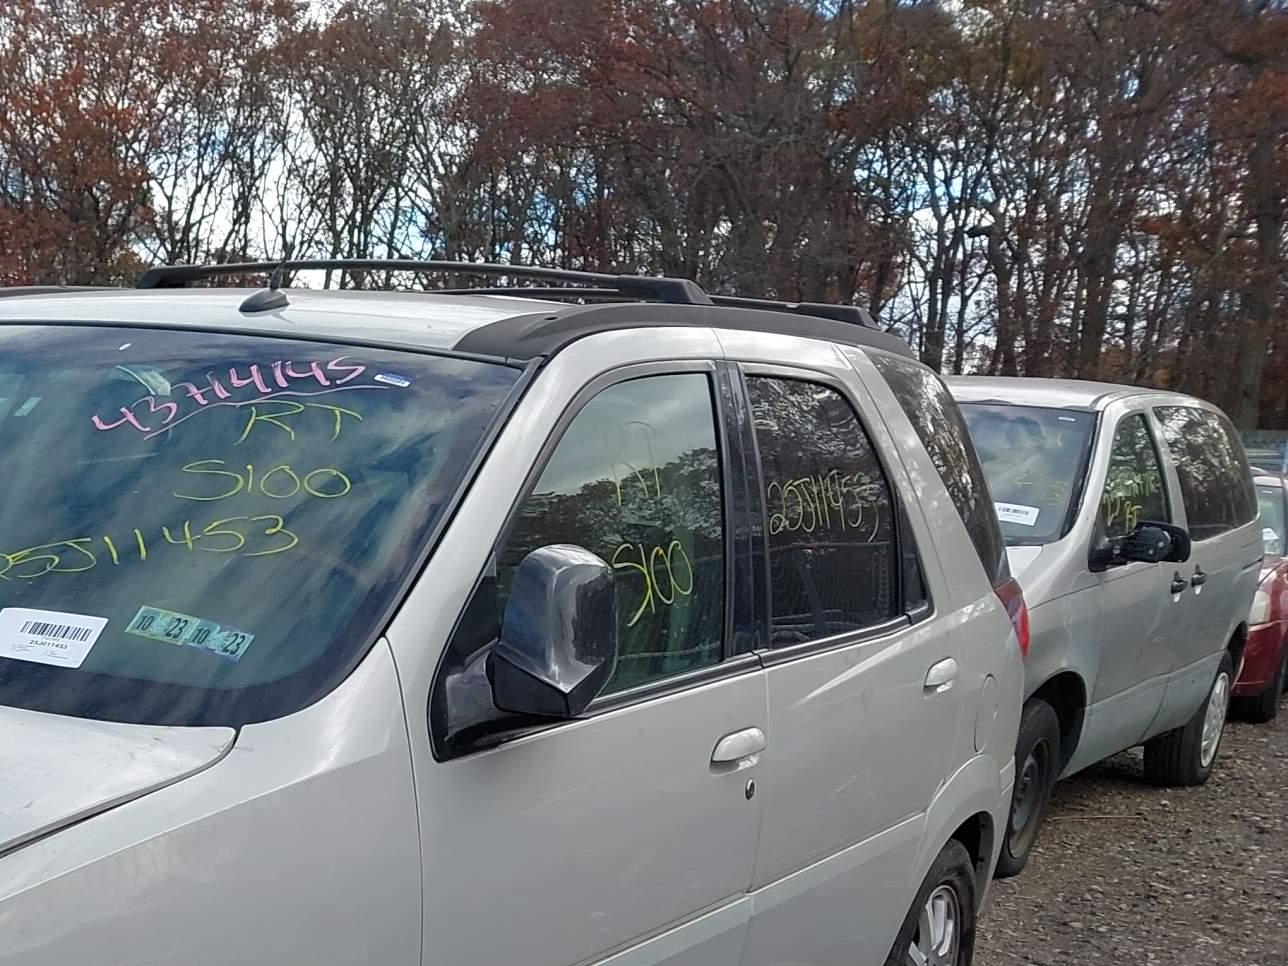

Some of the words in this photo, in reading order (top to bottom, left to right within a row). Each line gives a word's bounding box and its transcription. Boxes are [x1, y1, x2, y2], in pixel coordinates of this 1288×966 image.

[91, 355, 366, 432] 43714145
[232, 399, 363, 446] RT
[136, 615, 154, 631] 10
[165, 617, 188, 639] 23
[192, 627, 210, 645] 10
[223, 632, 246, 655] 23
